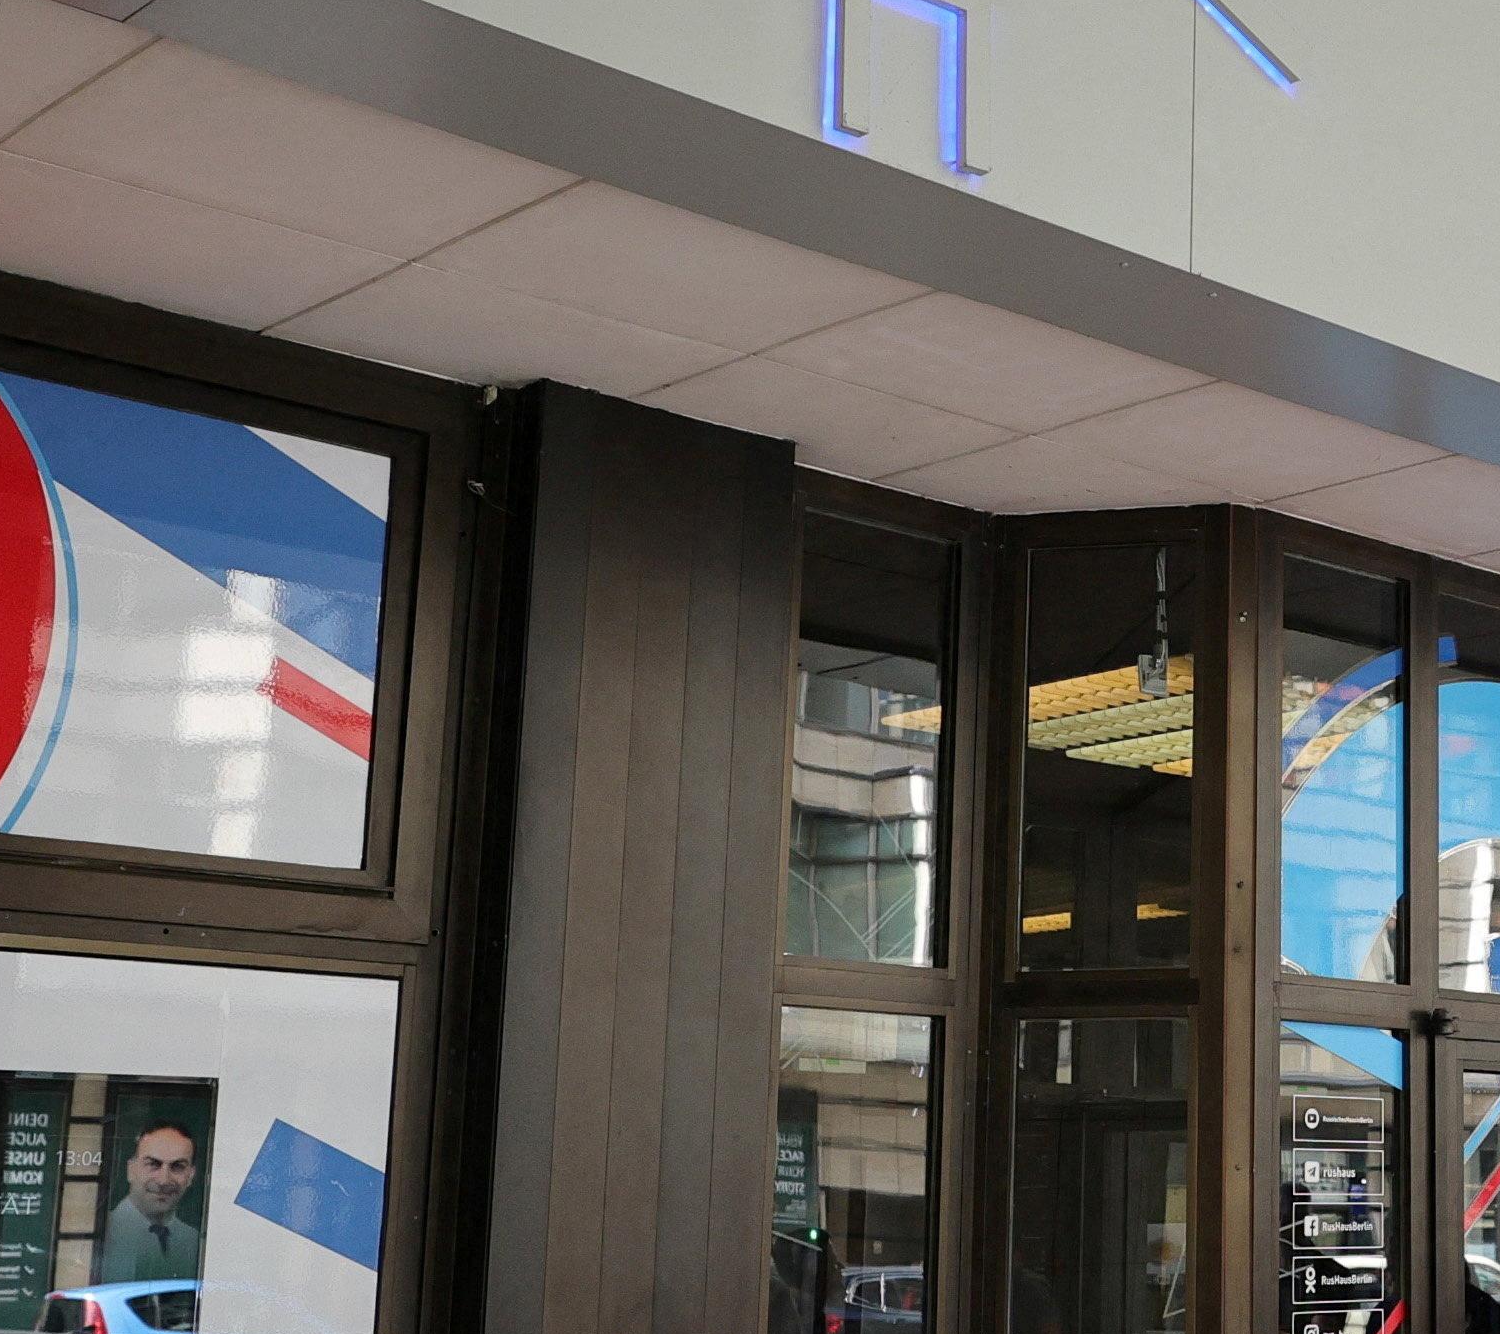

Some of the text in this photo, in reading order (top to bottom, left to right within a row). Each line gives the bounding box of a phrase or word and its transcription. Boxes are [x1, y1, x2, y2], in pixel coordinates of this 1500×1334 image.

[56, 1150, 104, 1166] 13:04
[1323, 1167, 1356, 1178] rushaus
[1322, 1221, 1373, 1232] RusHausBerlin
[1321, 1275, 1373, 1285] RusHausBerlin
